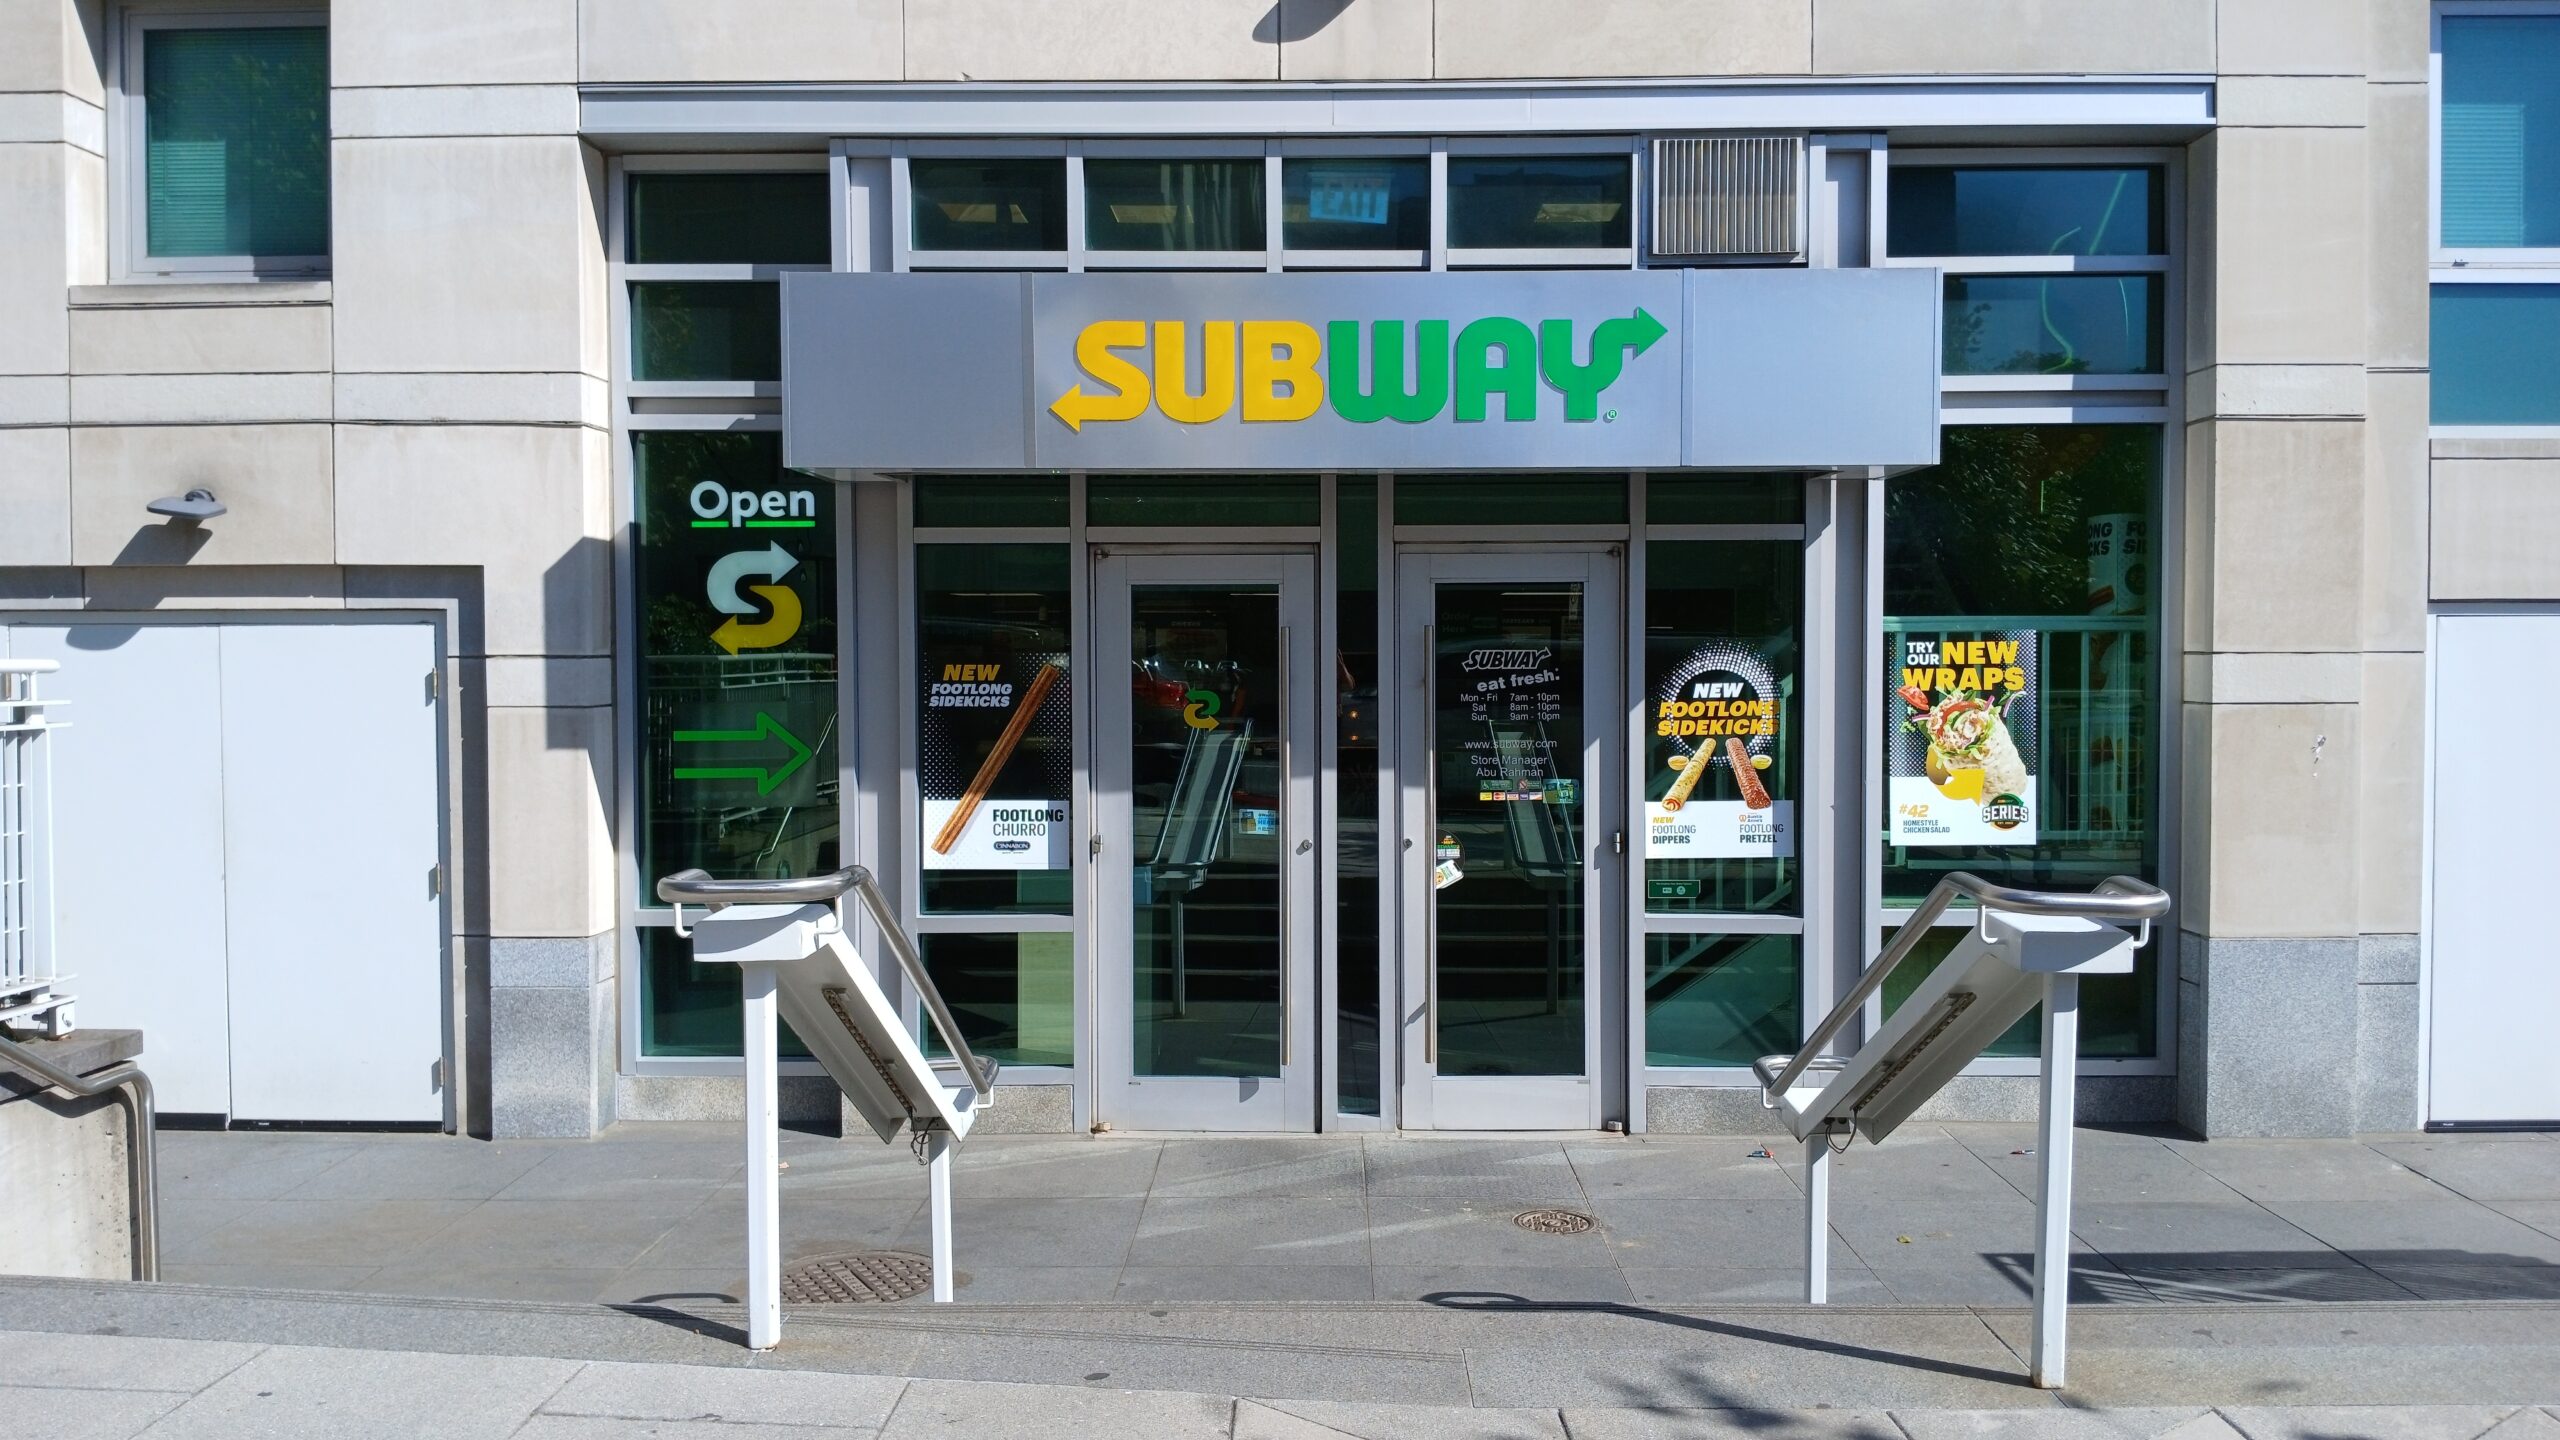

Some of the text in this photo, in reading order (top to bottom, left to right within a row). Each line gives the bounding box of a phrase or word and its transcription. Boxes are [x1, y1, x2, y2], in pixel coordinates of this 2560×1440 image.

[1320, 179, 1384, 218] EXIT
[1048, 306, 1668, 433] SUBWAY
[690, 480, 816, 528] Open
[1907, 642, 1936, 653] TRY
[1942, 641, 2019, 665] NEW
[1462, 646, 1552, 673] SUBWAY
[1907, 654, 1939, 665] OUR
[943, 664, 1001, 681] NEW
[1902, 666, 2025, 691] WRAPS
[931, 683, 1013, 695] FOOTLONG
[1477, 677, 1506, 692] eat
[1692, 682, 1744, 699] NEW
[929, 695, 1010, 707] SIDEKICKS
[1460, 693, 1479, 702] Mon
[1486, 693, 1498, 702] Fri
[1510, 693, 1528, 702] 7am
[1538, 693, 1560, 703] 10pm
[1472, 703, 1487, 712] Sat
[1510, 703, 1528, 711] 8am
[1538, 703, 1560, 713] 10pm
[1659, 700, 1779, 718] FOOTLONG
[1471, 713, 1488, 721] Sun
[1538, 712, 1560, 722] 10pm
[1657, 719, 1779, 736] SIDEKICKS
[1464, 740, 1558, 750] www.subway.com
[1471, 755, 1548, 766] Store Manager
[1476, 767, 1544, 777] Abu Rahman
[992, 809, 1064, 822] FOOTLONG
[1899, 803, 1929, 818] #42
[1982, 805, 2029, 823] SERIES
[1652, 816, 1675, 824] NEW
[993, 823, 1046, 836] CHURRO
[1652, 825, 1697, 834] FOOTLONG
[1739, 823, 1784, 833] FOOTLONG
[1652, 835, 1691, 844] DIPPERS
[1739, 834, 1778, 843] PRETZEL
